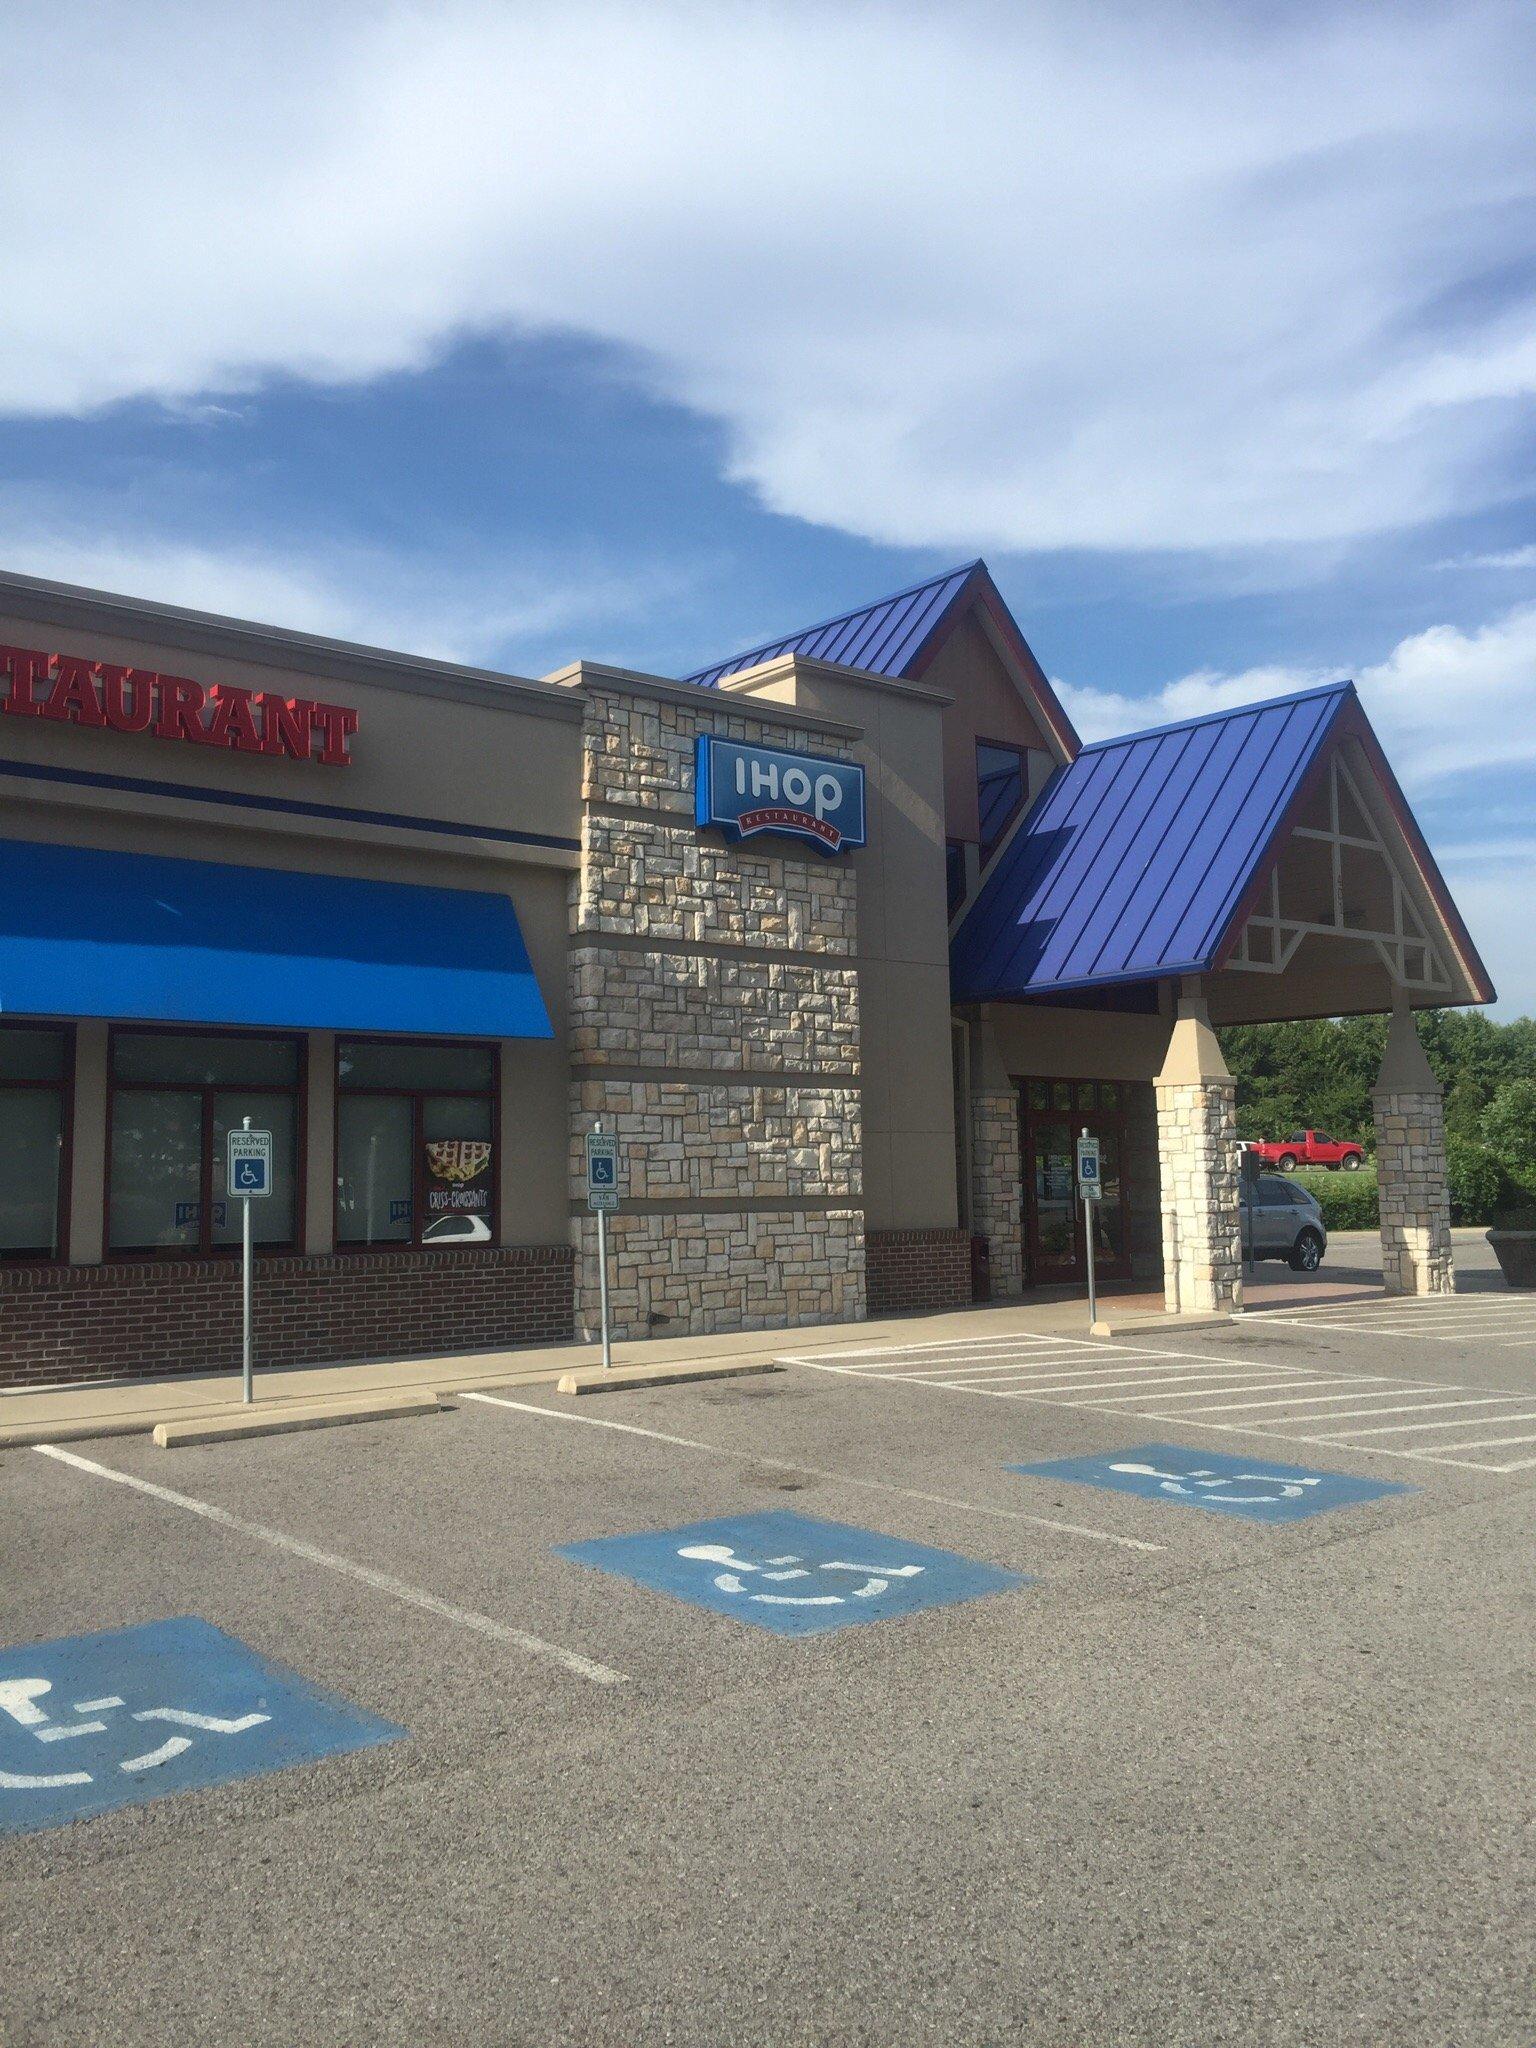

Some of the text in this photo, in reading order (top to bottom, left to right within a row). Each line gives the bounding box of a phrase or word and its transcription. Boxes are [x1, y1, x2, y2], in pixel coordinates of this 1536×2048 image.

[735, 757, 843, 820] IHOP
[746, 812, 835, 839] RESTAURANT
[231, 1137, 269, 1146] RESERVED
[233, 1148, 266, 1157] PARKING
